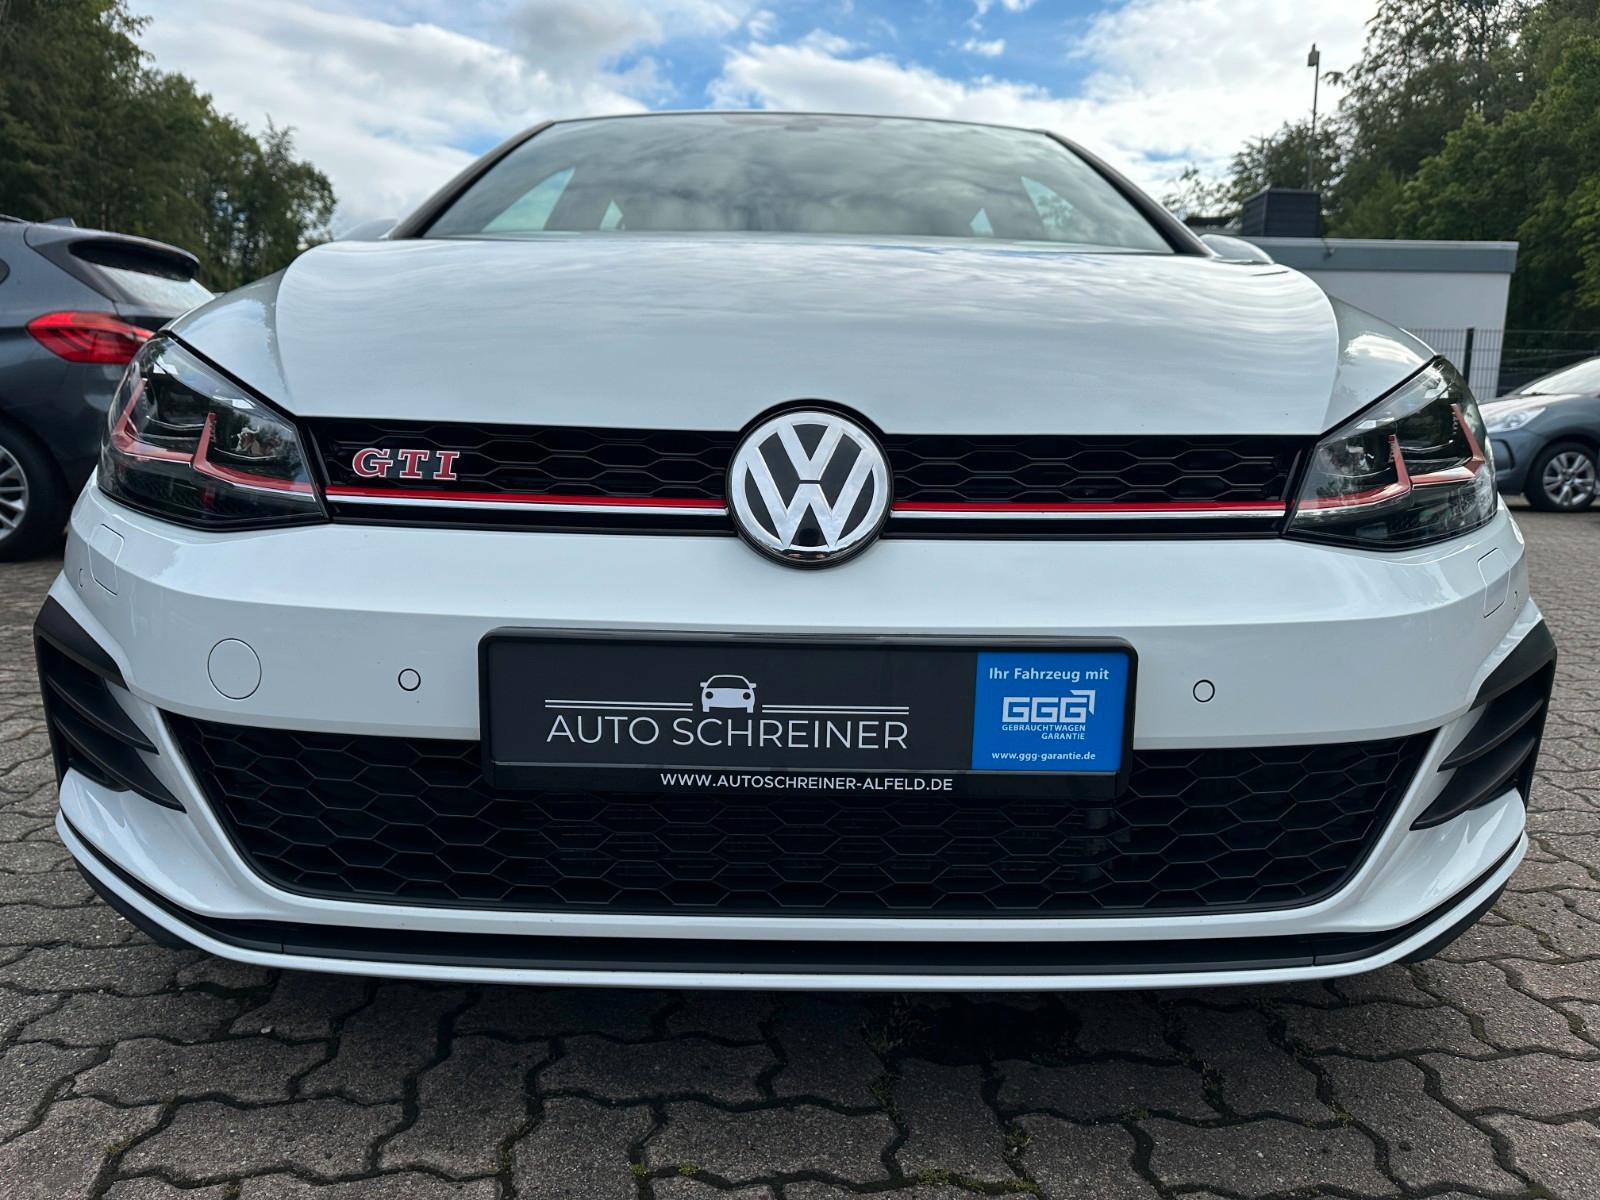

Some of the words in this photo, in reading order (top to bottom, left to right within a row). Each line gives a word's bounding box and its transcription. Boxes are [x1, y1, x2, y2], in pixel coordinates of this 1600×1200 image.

[351, 447, 461, 482] GTI
[988, 667, 1010, 680] Ihr
[1013, 667, 1081, 683] Fahrzeug
[1085, 668, 1110, 681] mit
[1001, 696, 1088, 723] GGG
[545, 714, 660, 745] AUTO
[671, 717, 909, 750] SCHREINER
[1001, 723, 1087, 732] GEBRAUCHTWAGEN
[1040, 732, 1086, 741] GARANTIE
[991, 751, 1097, 762] www.ggg-garantie.de
[659, 772, 954, 792] WWW.AUTOSCHREINER-ALFELD.DE
